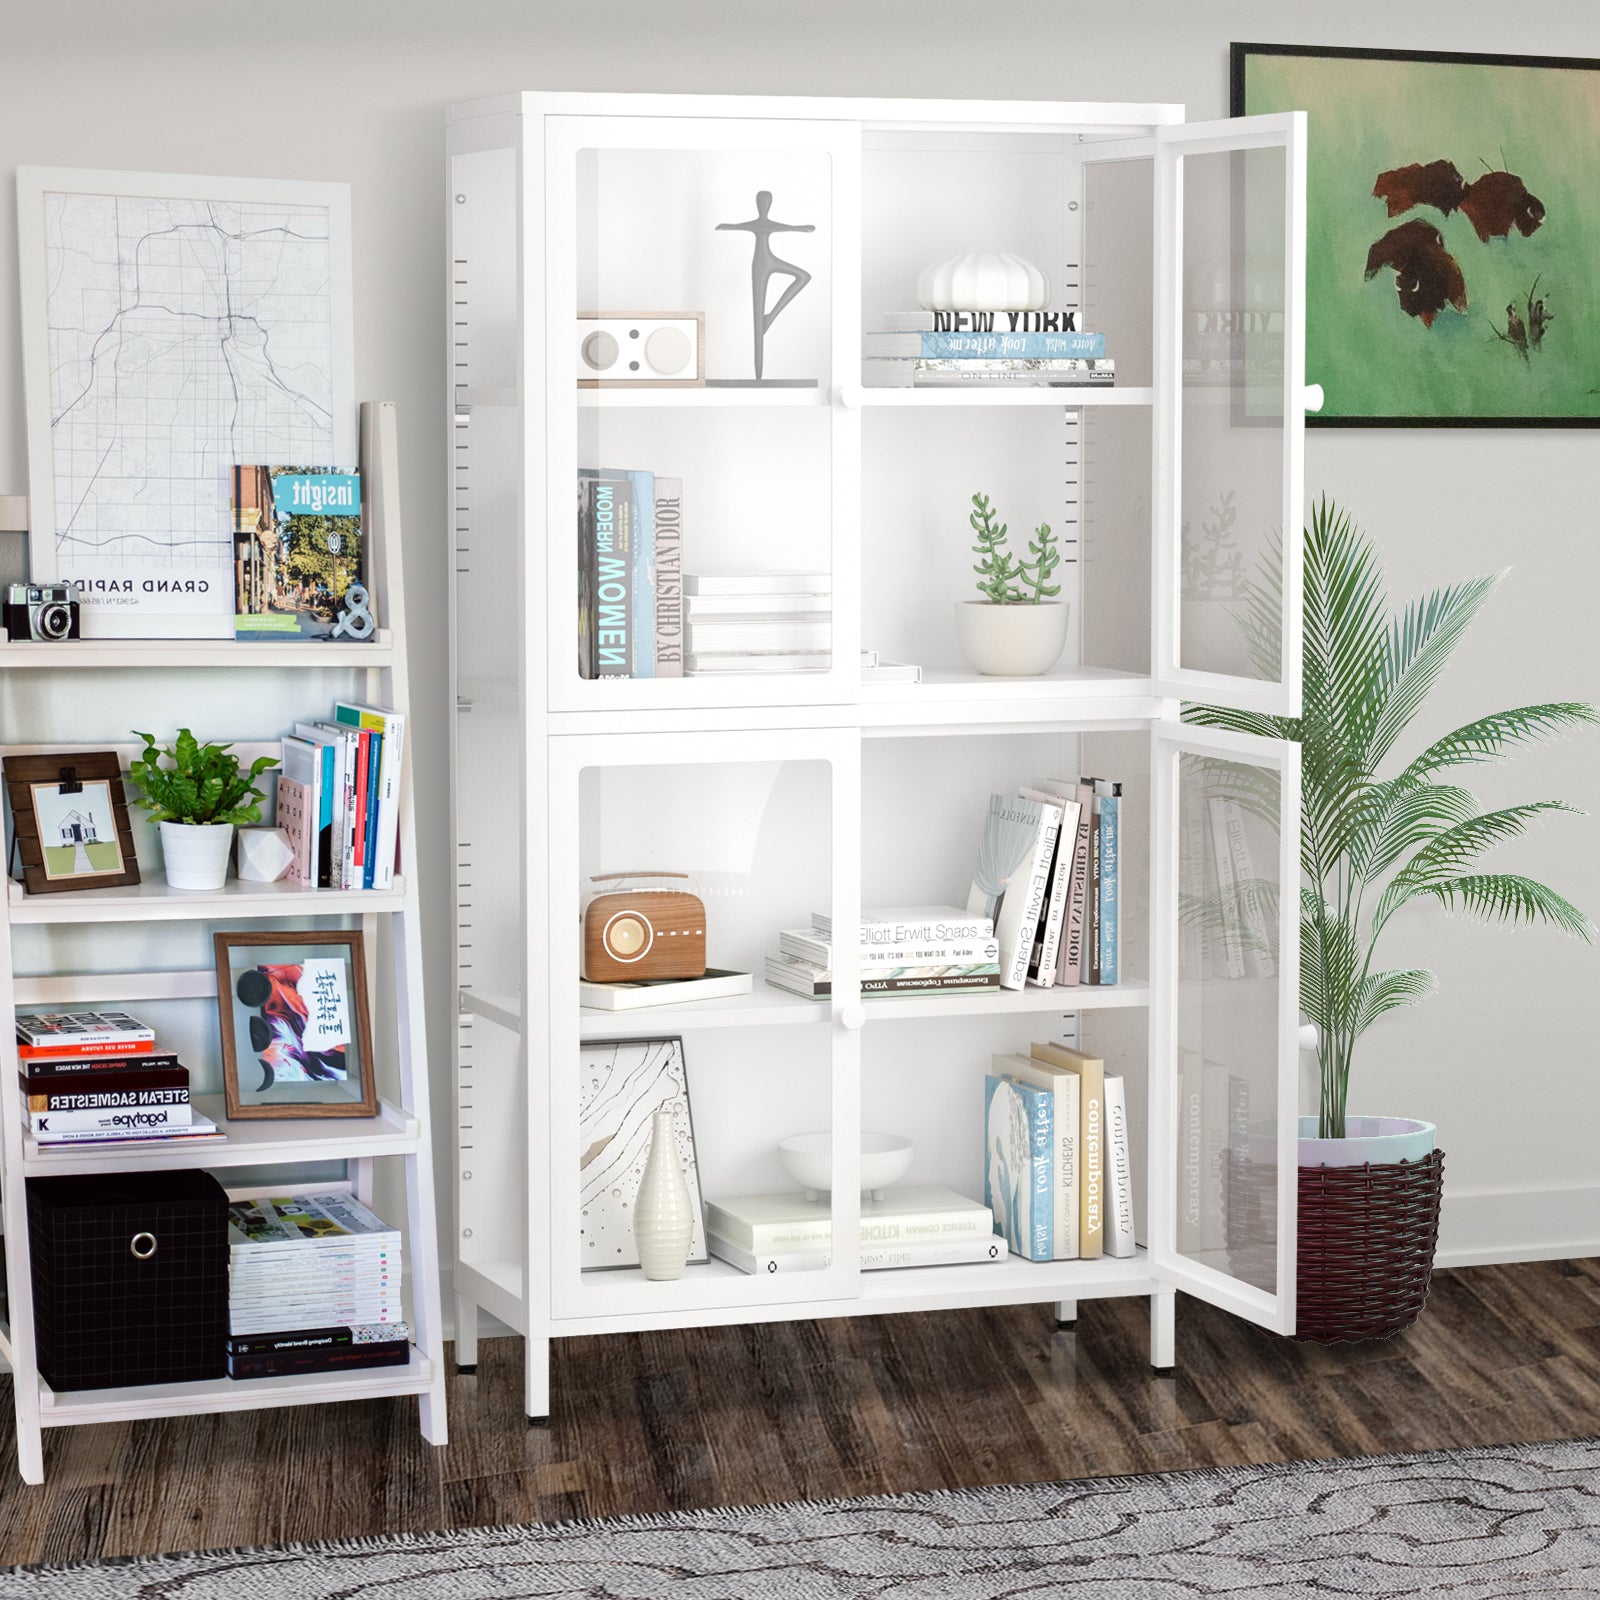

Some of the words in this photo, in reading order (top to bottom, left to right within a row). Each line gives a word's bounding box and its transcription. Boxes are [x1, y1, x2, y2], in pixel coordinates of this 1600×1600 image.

[933, 312, 995, 332] NEW
[1007, 312, 1076, 332] YORK
[948, 338, 962, 350] me
[965, 337, 995, 354] after
[1001, 336, 1026, 354] Look
[656, 497, 681, 541] DIOR
[656, 546, 681, 637] CHRISTIAN
[656, 641, 681, 664] BY
[896, 926, 931, 941] Erwitt
[935, 924, 978, 941] Snaps
[865, 981, 889, 989] УТРО
[1185, 1094, 1201, 1226] contemporary
[860, 1224, 900, 1241] KITCHE
[906, 1224, 940, 1234] CONRAN
[941, 1222, 976, 1232] TERENCE
